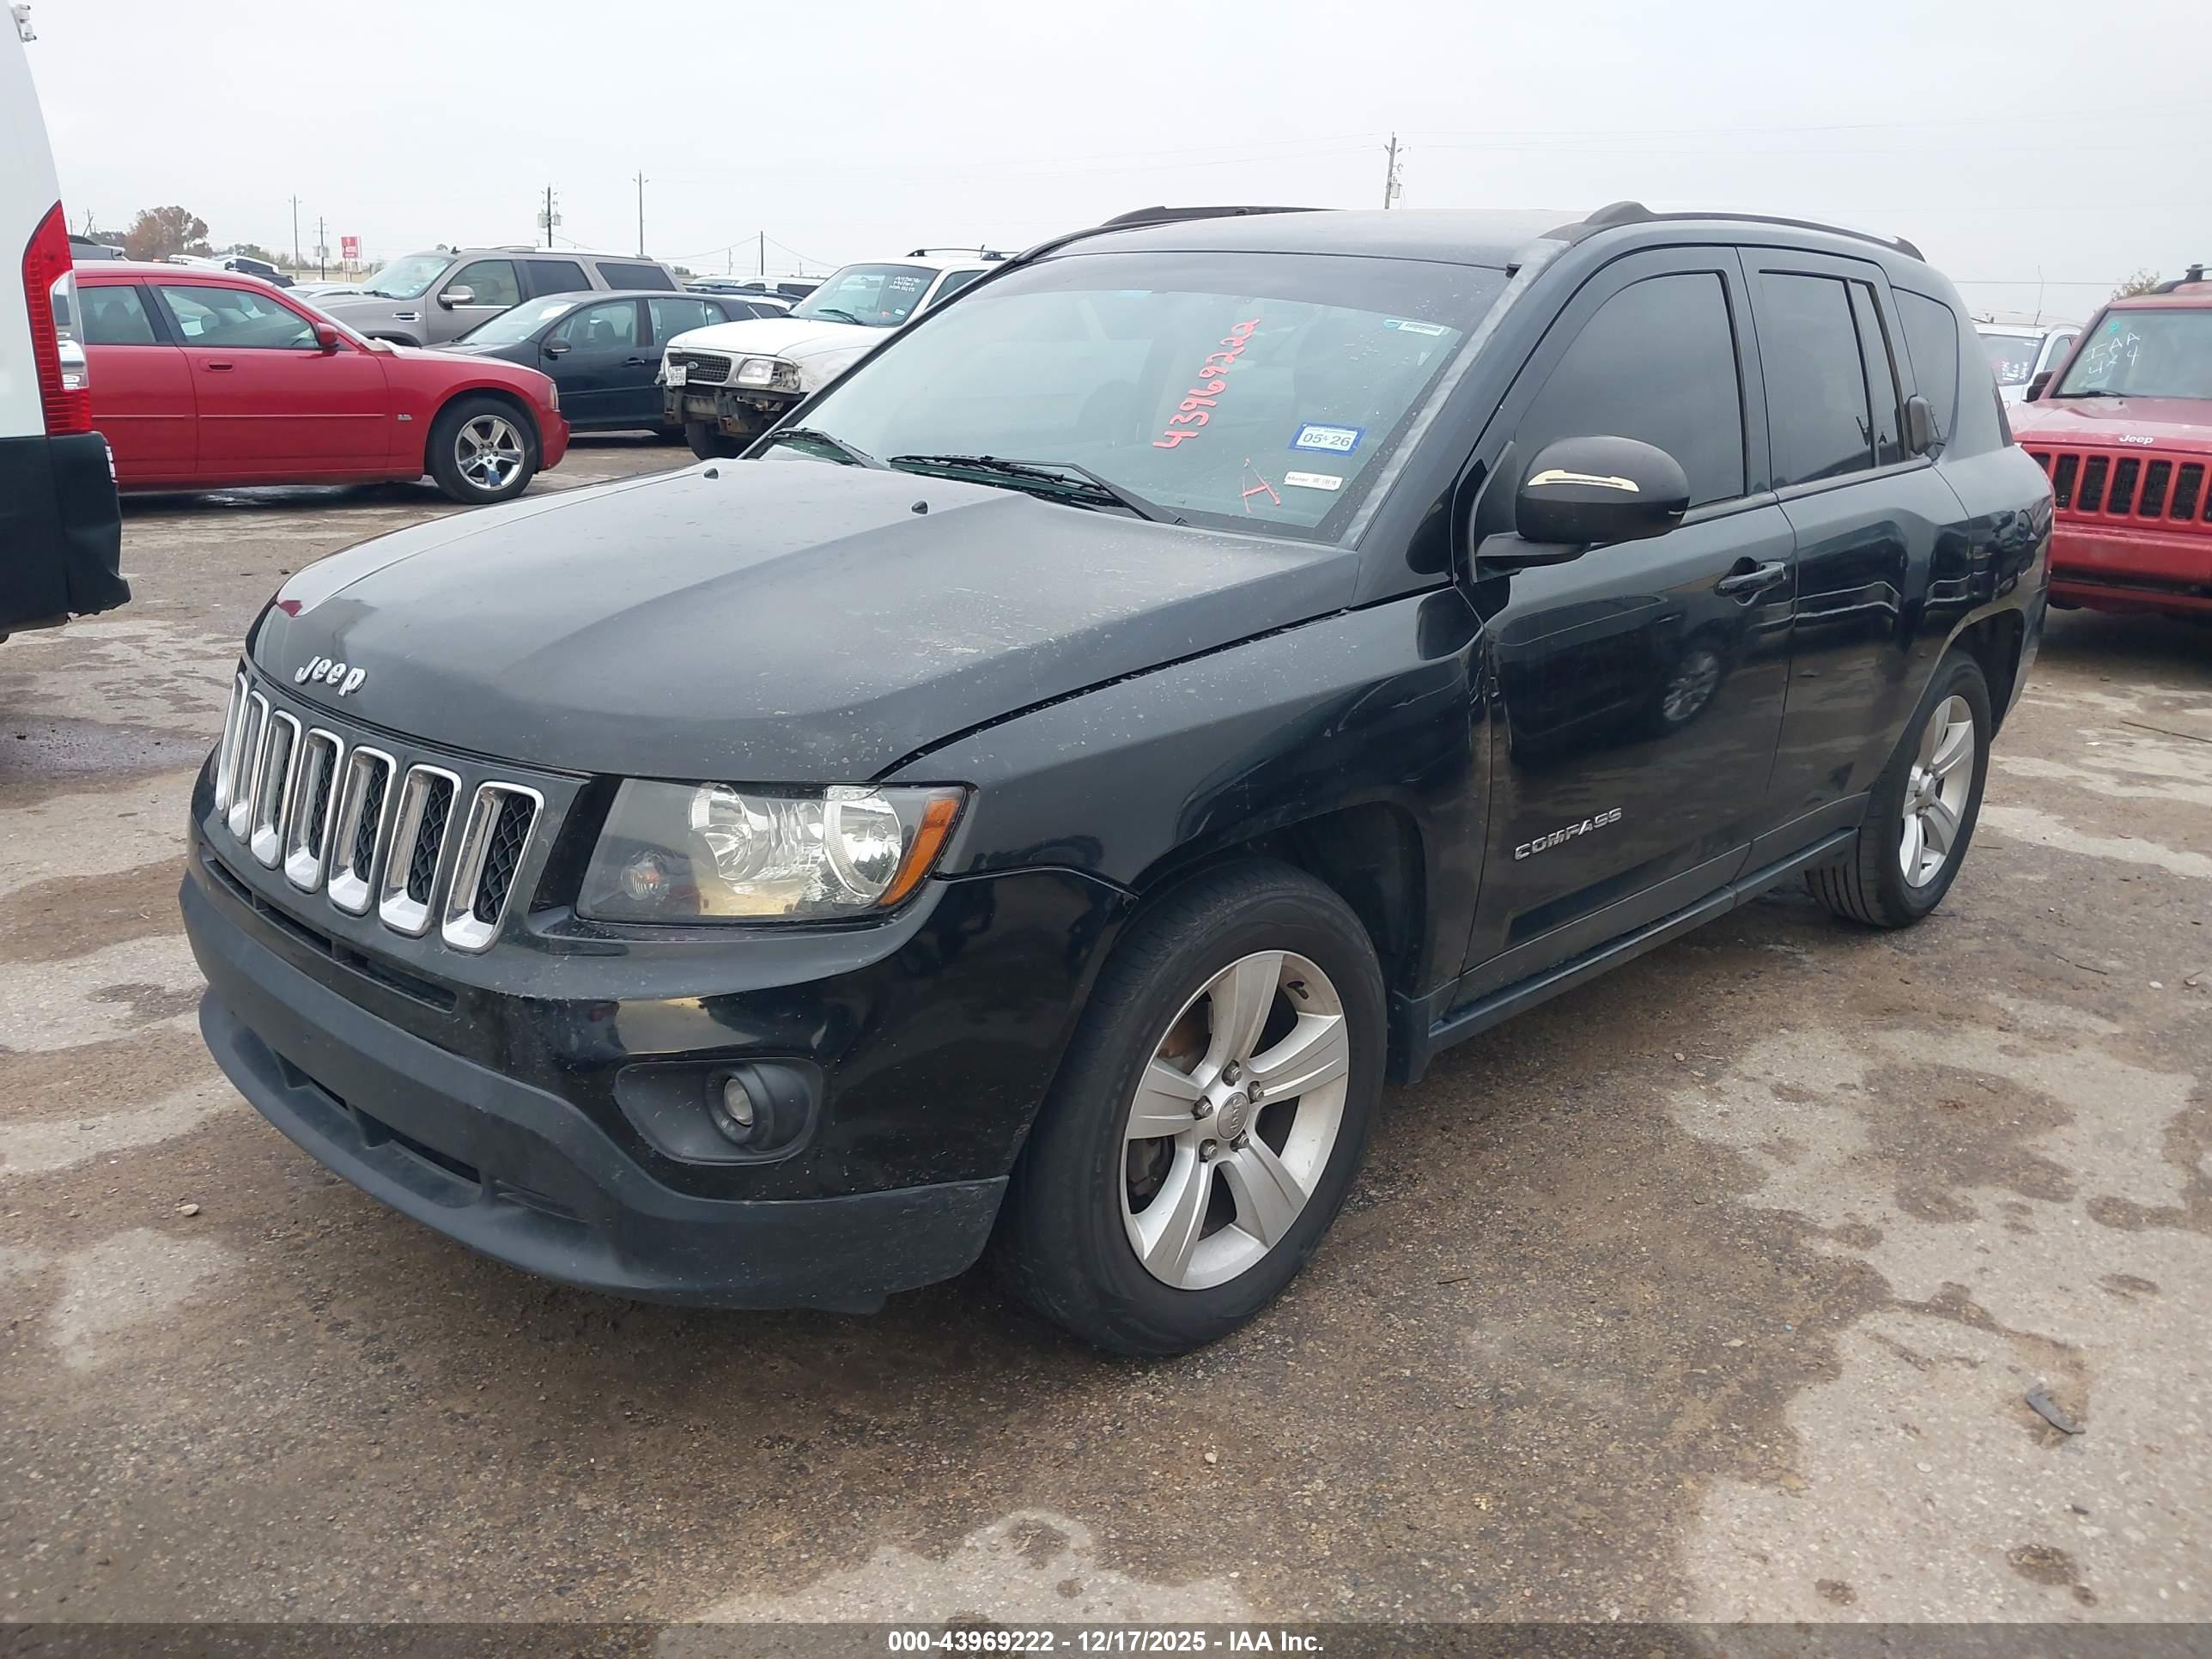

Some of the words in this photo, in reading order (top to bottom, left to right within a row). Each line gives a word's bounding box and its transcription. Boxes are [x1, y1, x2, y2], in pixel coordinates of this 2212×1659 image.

[1152, 317, 1261, 448] 43969222
[1303, 433, 1323, 444] 05
[1329, 435, 1352, 447] 26
[2118, 434, 2154, 446] Jeep
[295, 655, 368, 697] Jeep
[1515, 807, 1622, 860] COMPASS
